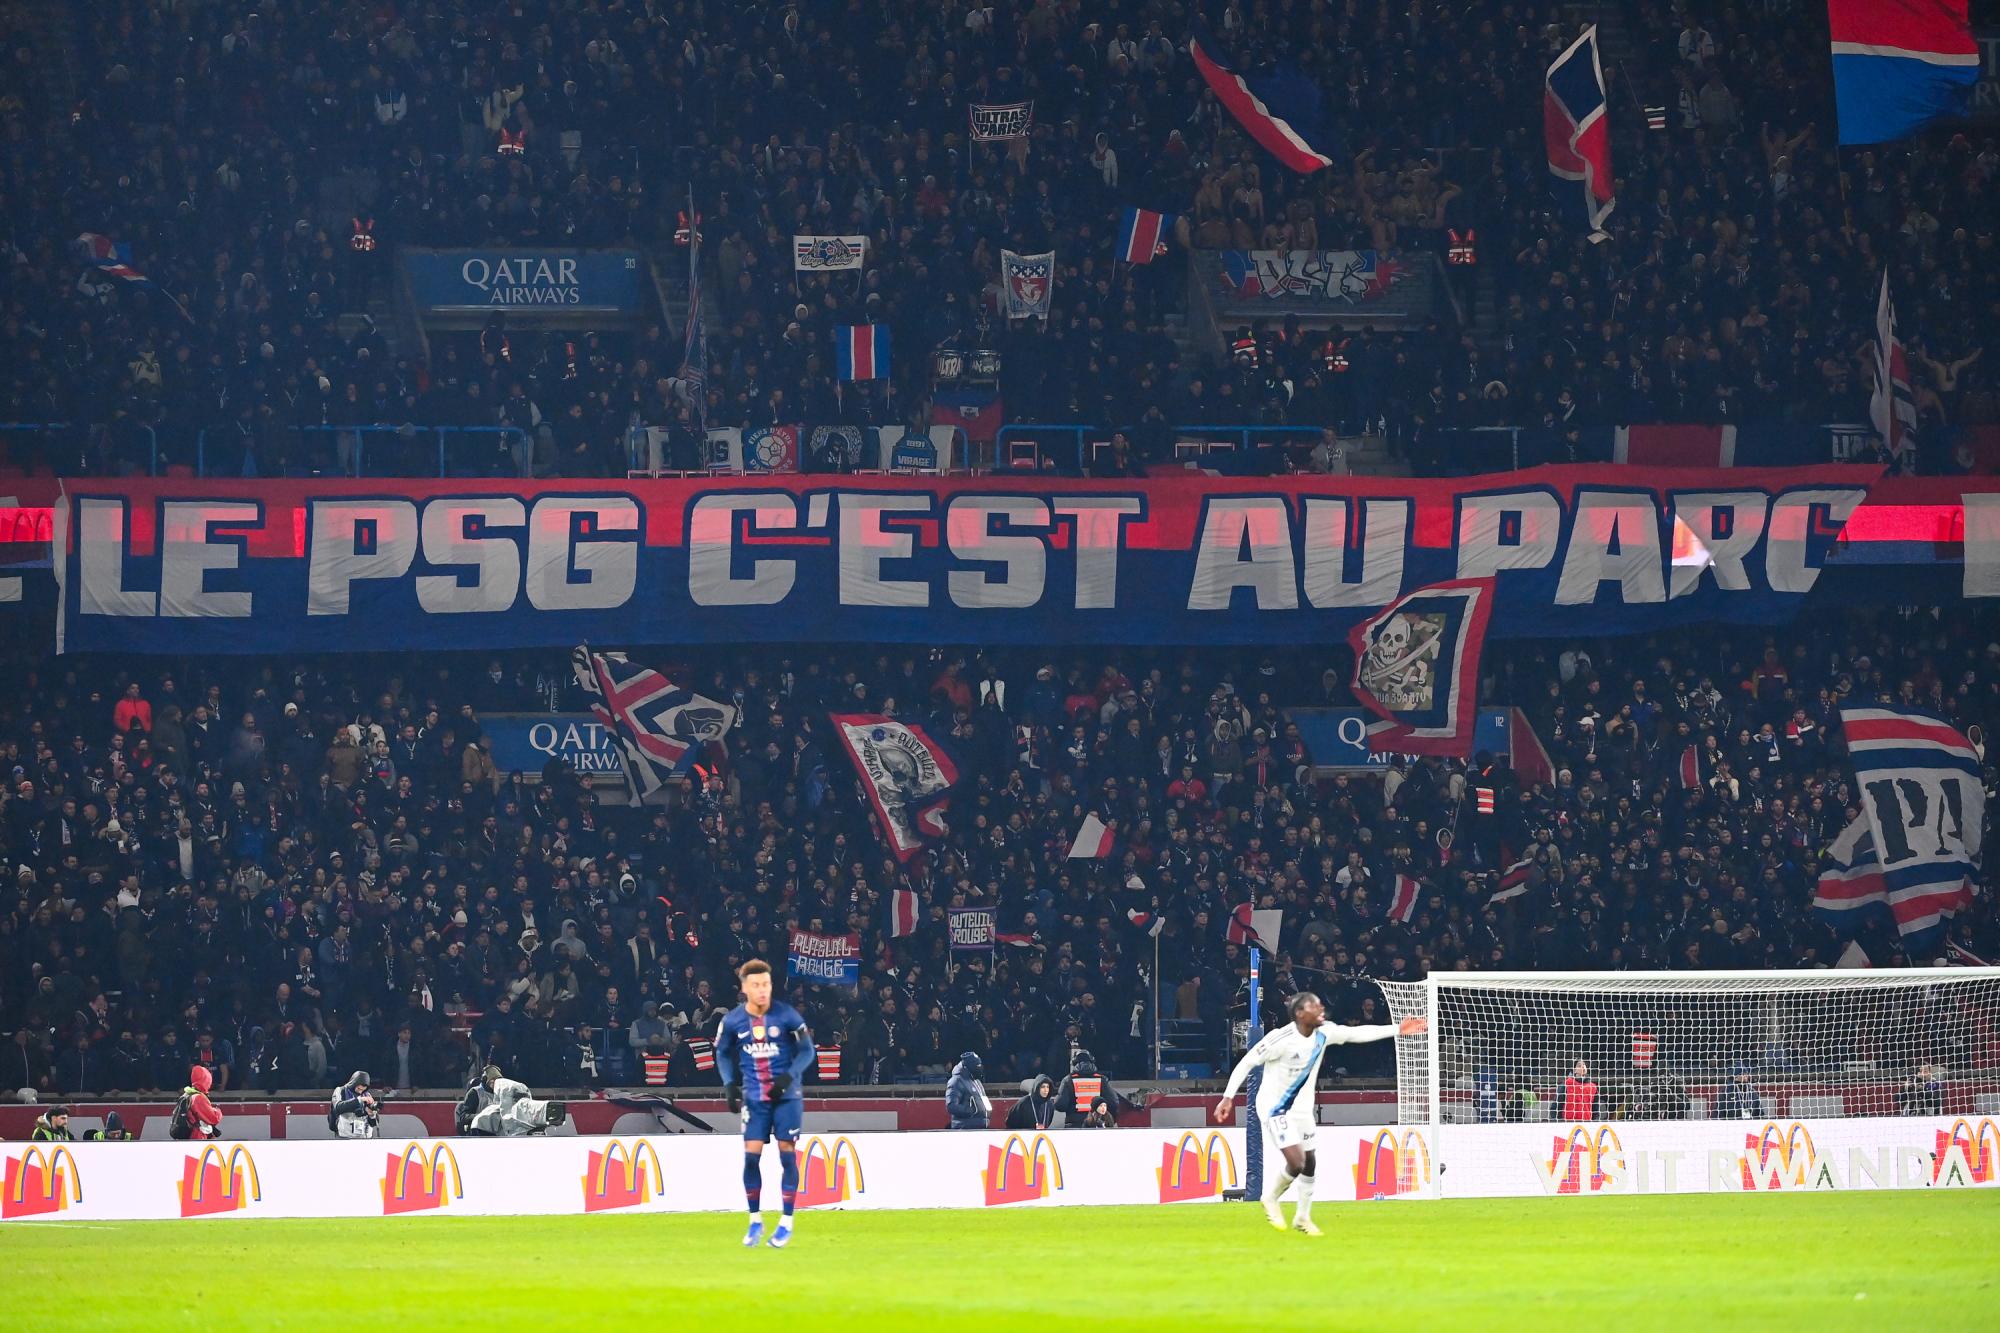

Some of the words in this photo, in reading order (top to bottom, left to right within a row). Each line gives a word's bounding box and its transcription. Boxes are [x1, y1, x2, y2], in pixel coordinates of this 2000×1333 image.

[975, 109, 1027, 124] ULTRAS
[979, 122, 1022, 136] PARIS
[624, 258, 636, 269] 313
[462, 258, 579, 291] QATAR
[490, 287, 580, 304] AIRWAYS
[897, 455, 931, 467] VIRAGE
[80, 498, 258, 617] LE
[307, 497, 639, 615] PSG
[688, 493, 1141, 608] C'EST
[1187, 497, 1408, 611] AU
[1457, 488, 1866, 604] PARC
[529, 723, 610, 757] QAT
[949, 912, 994, 928] AUTEUIL
[955, 928, 988, 944] ROUGE
[794, 934, 852, 958] AUTEUIL
[796, 956, 844, 978] ROUGE
[1274, 1115, 1288, 1130] 19
[1530, 1150, 1686, 1195] VISIT
[1708, 1145, 1975, 1191] RWANDA
